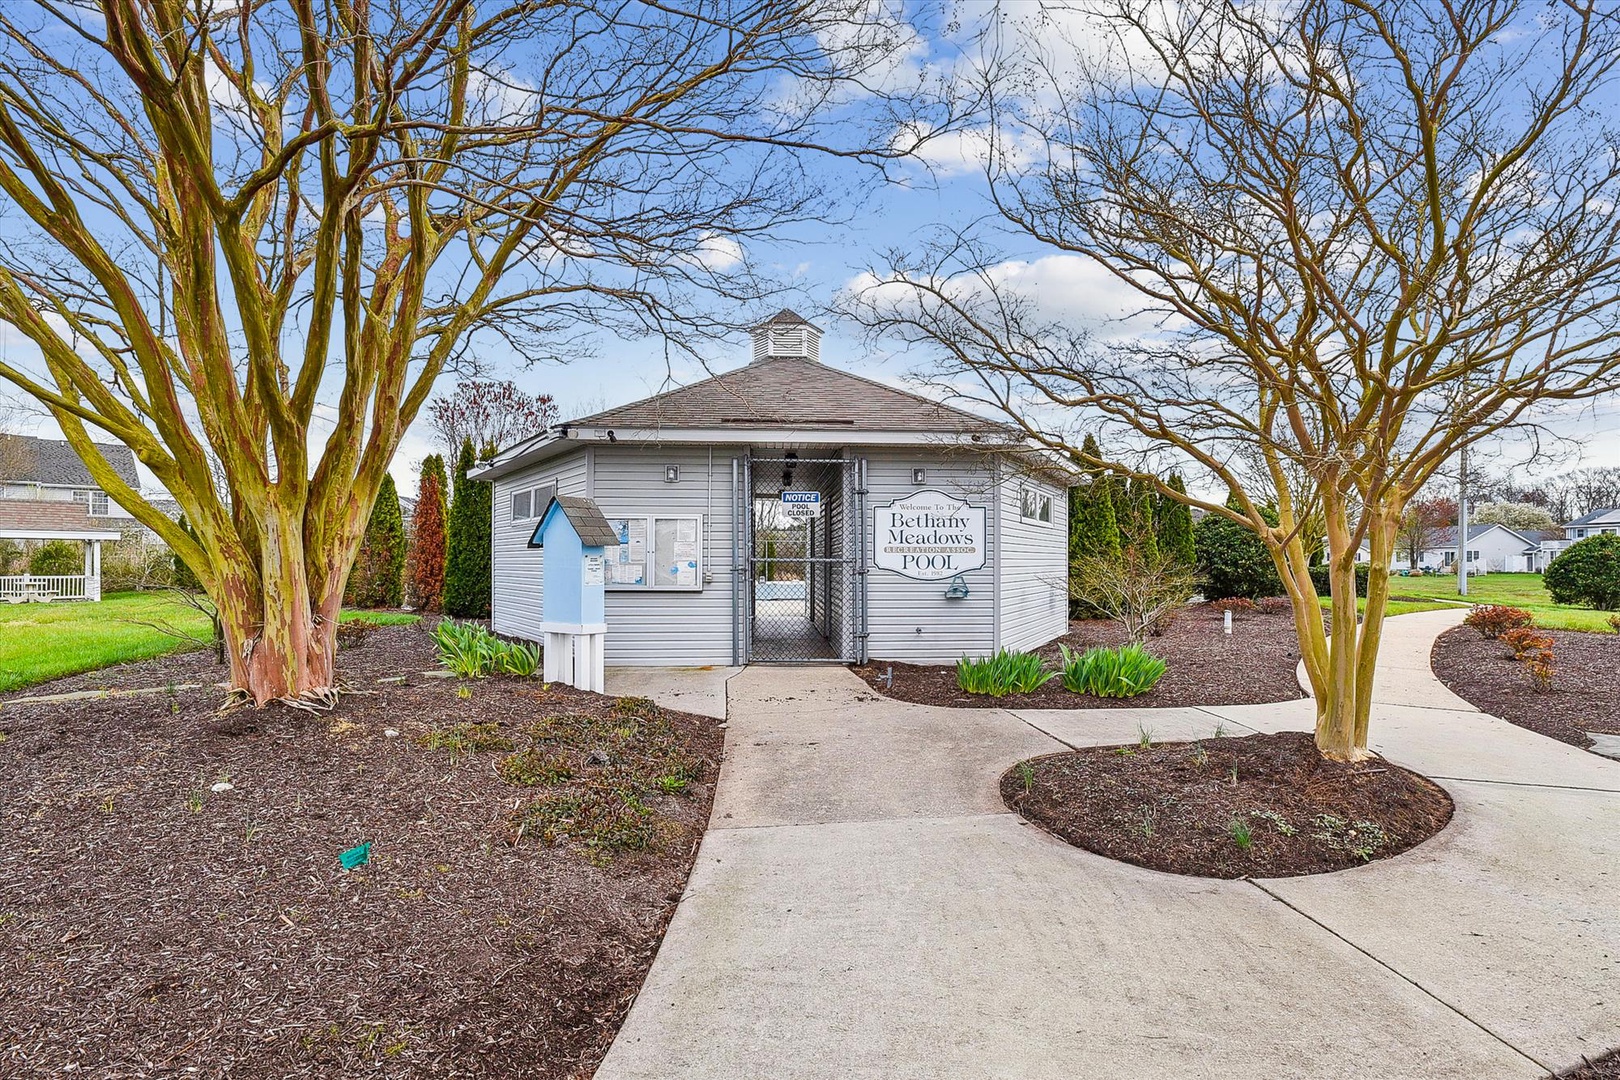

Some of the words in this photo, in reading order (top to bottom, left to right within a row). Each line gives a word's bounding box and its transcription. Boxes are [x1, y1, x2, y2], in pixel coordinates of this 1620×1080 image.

[785, 494, 816, 502] NOTICE
[899, 503, 932, 511] Welcome
[934, 503, 944, 511] To
[946, 503, 960, 511] The
[890, 513, 970, 532] Bethany
[888, 529, 974, 545] Meadows
[902, 554, 960, 571] POOL
